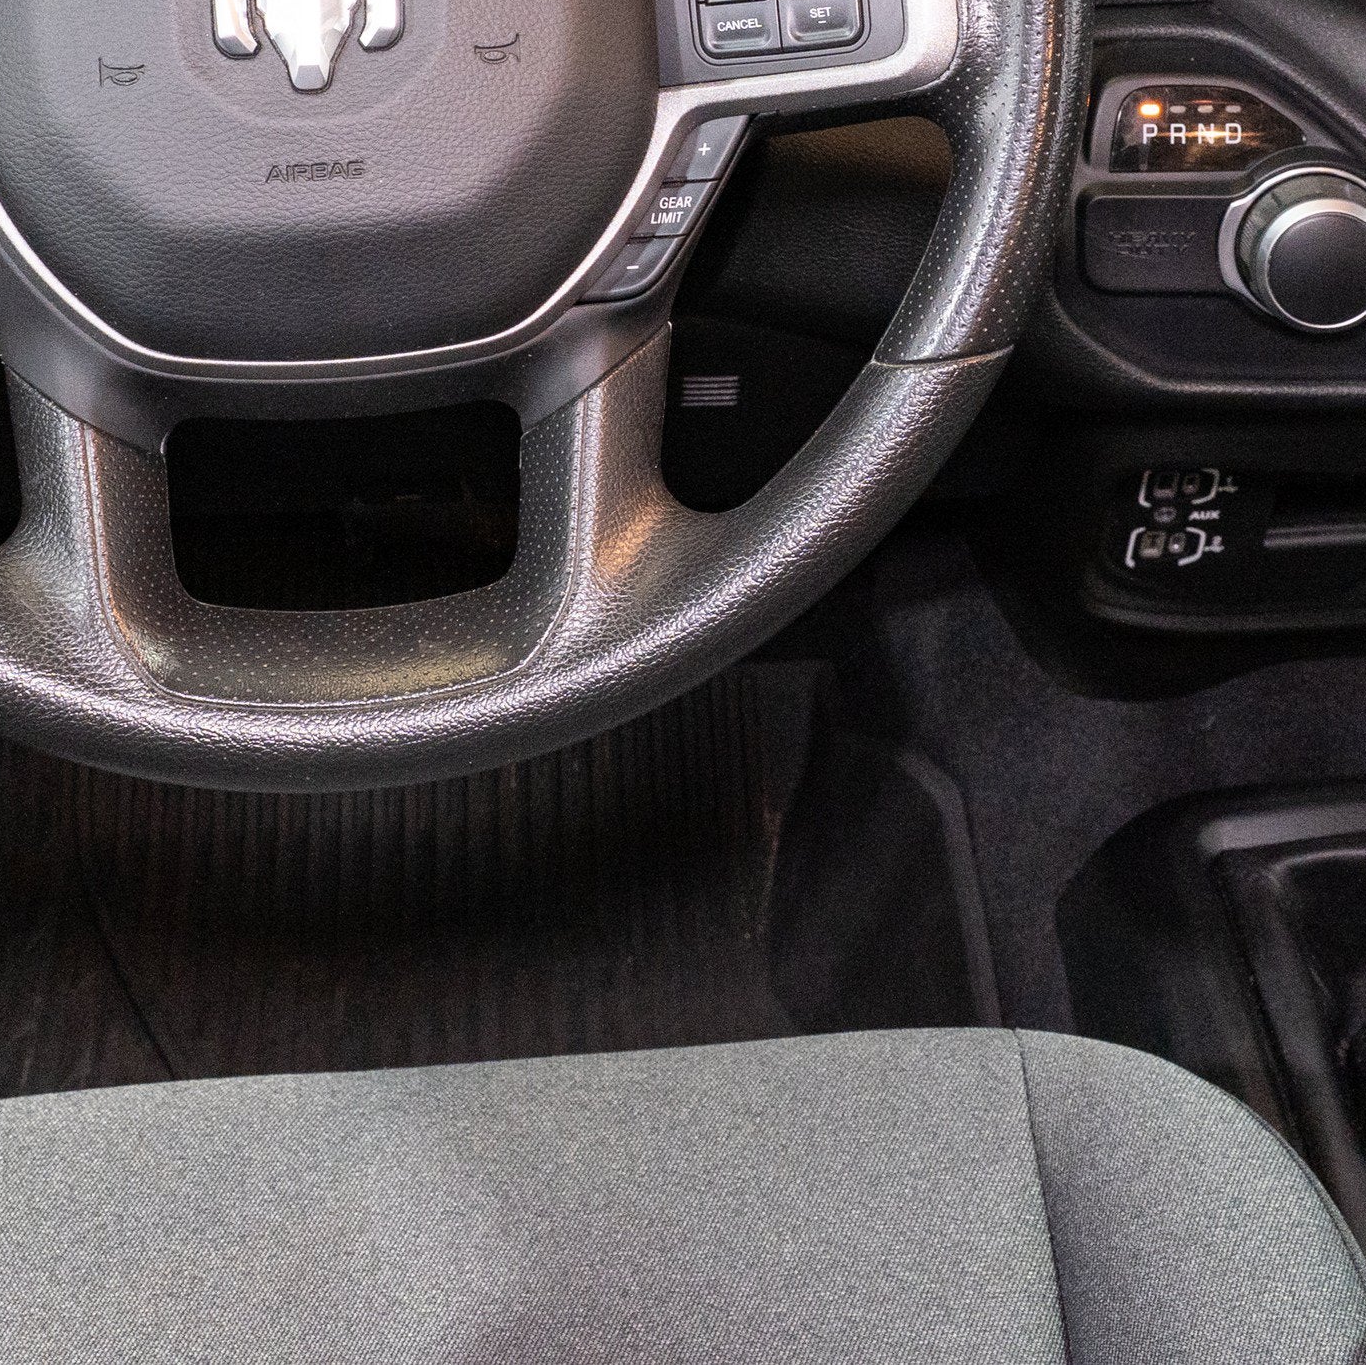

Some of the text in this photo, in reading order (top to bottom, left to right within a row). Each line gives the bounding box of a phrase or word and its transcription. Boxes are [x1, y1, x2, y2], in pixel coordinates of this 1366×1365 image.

[809, 7, 832, 19] SET
[717, 18, 763, 33] CANCEL
[1142, 123, 1243, 145] P R N D
[265, 159, 367, 184] AIRBAG
[659, 196, 693, 210] GEAR
[650, 211, 684, 225] LIMIT
[1188, 510, 1221, 521] AUX
